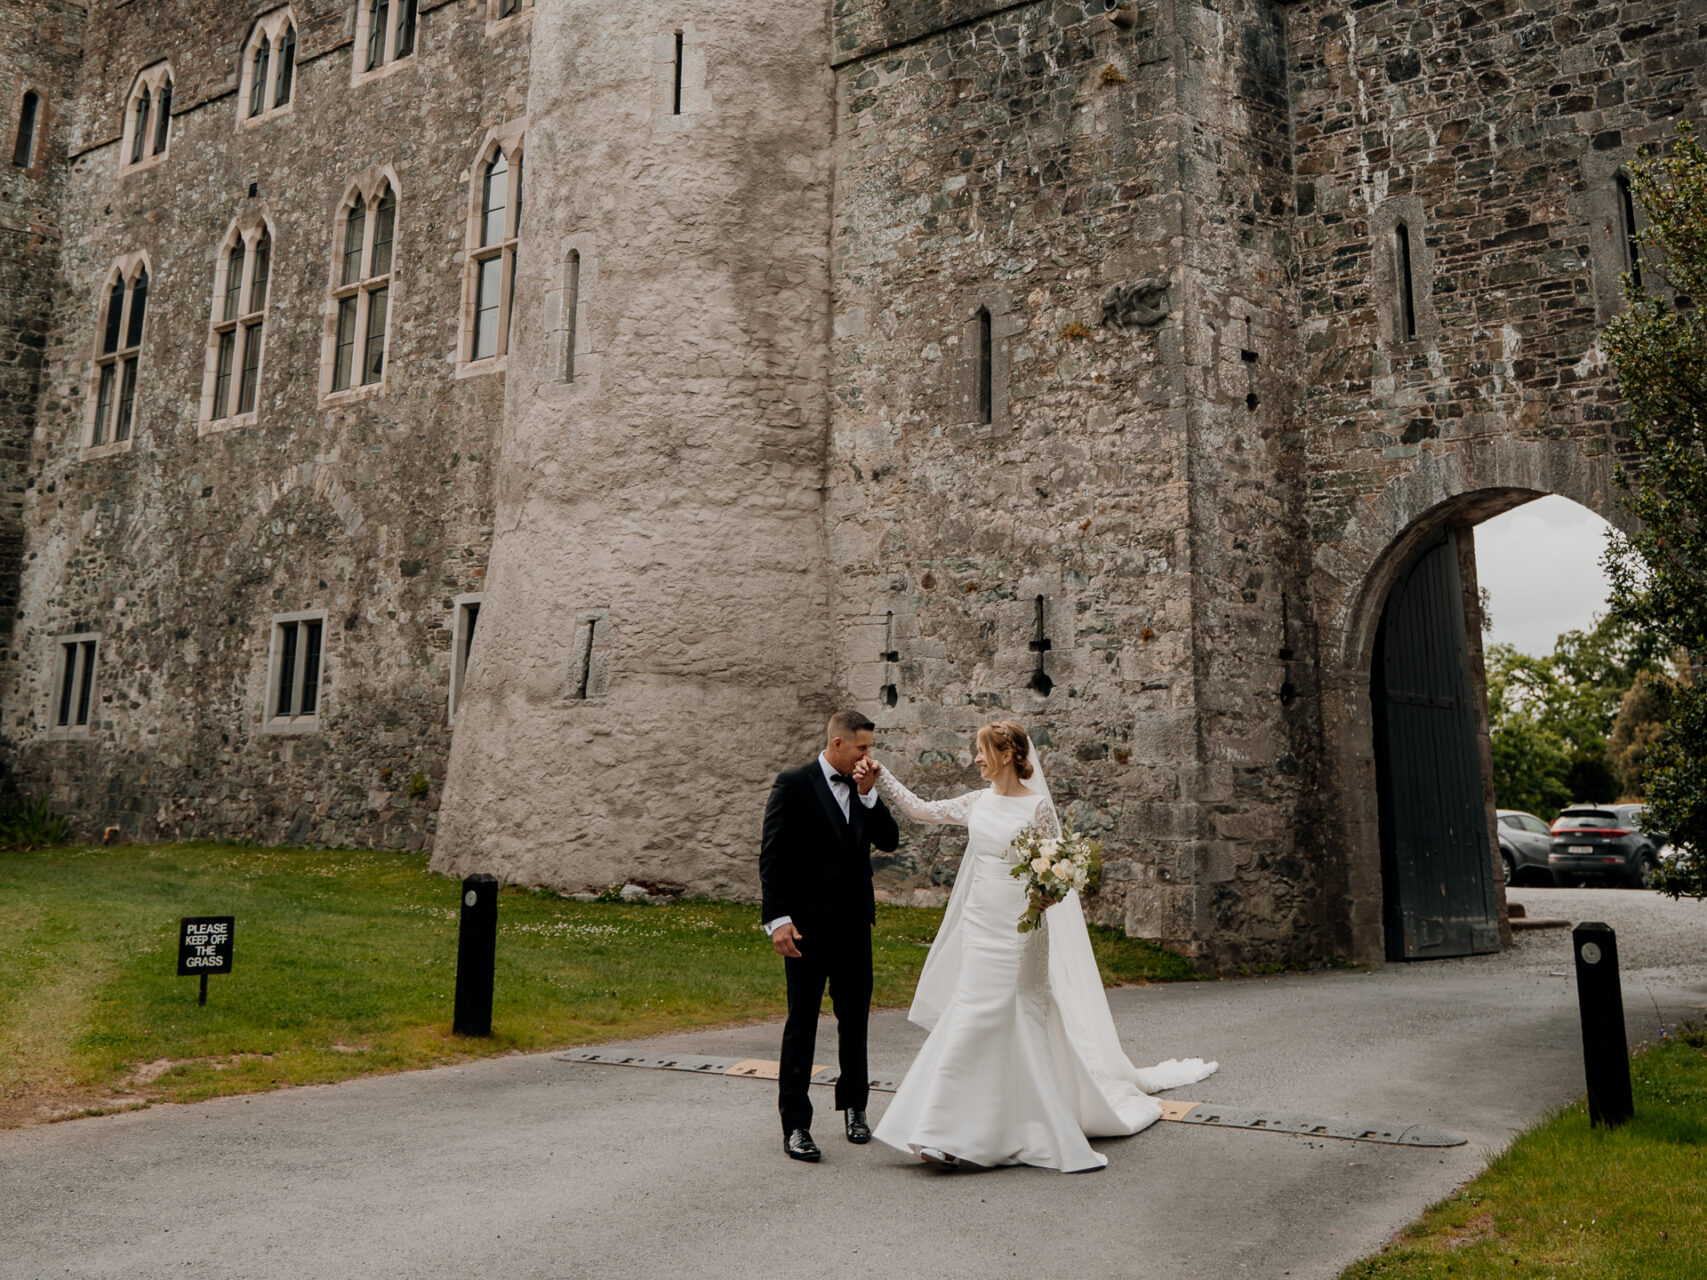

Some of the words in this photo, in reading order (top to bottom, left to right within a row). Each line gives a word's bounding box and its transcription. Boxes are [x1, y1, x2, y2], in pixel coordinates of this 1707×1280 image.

[187, 923, 228, 935] PLEASE
[185, 935, 208, 945] KEEP
[210, 934, 228, 944] OFF
[195, 945, 216, 956] THE
[186, 956, 224, 967] GRASS
